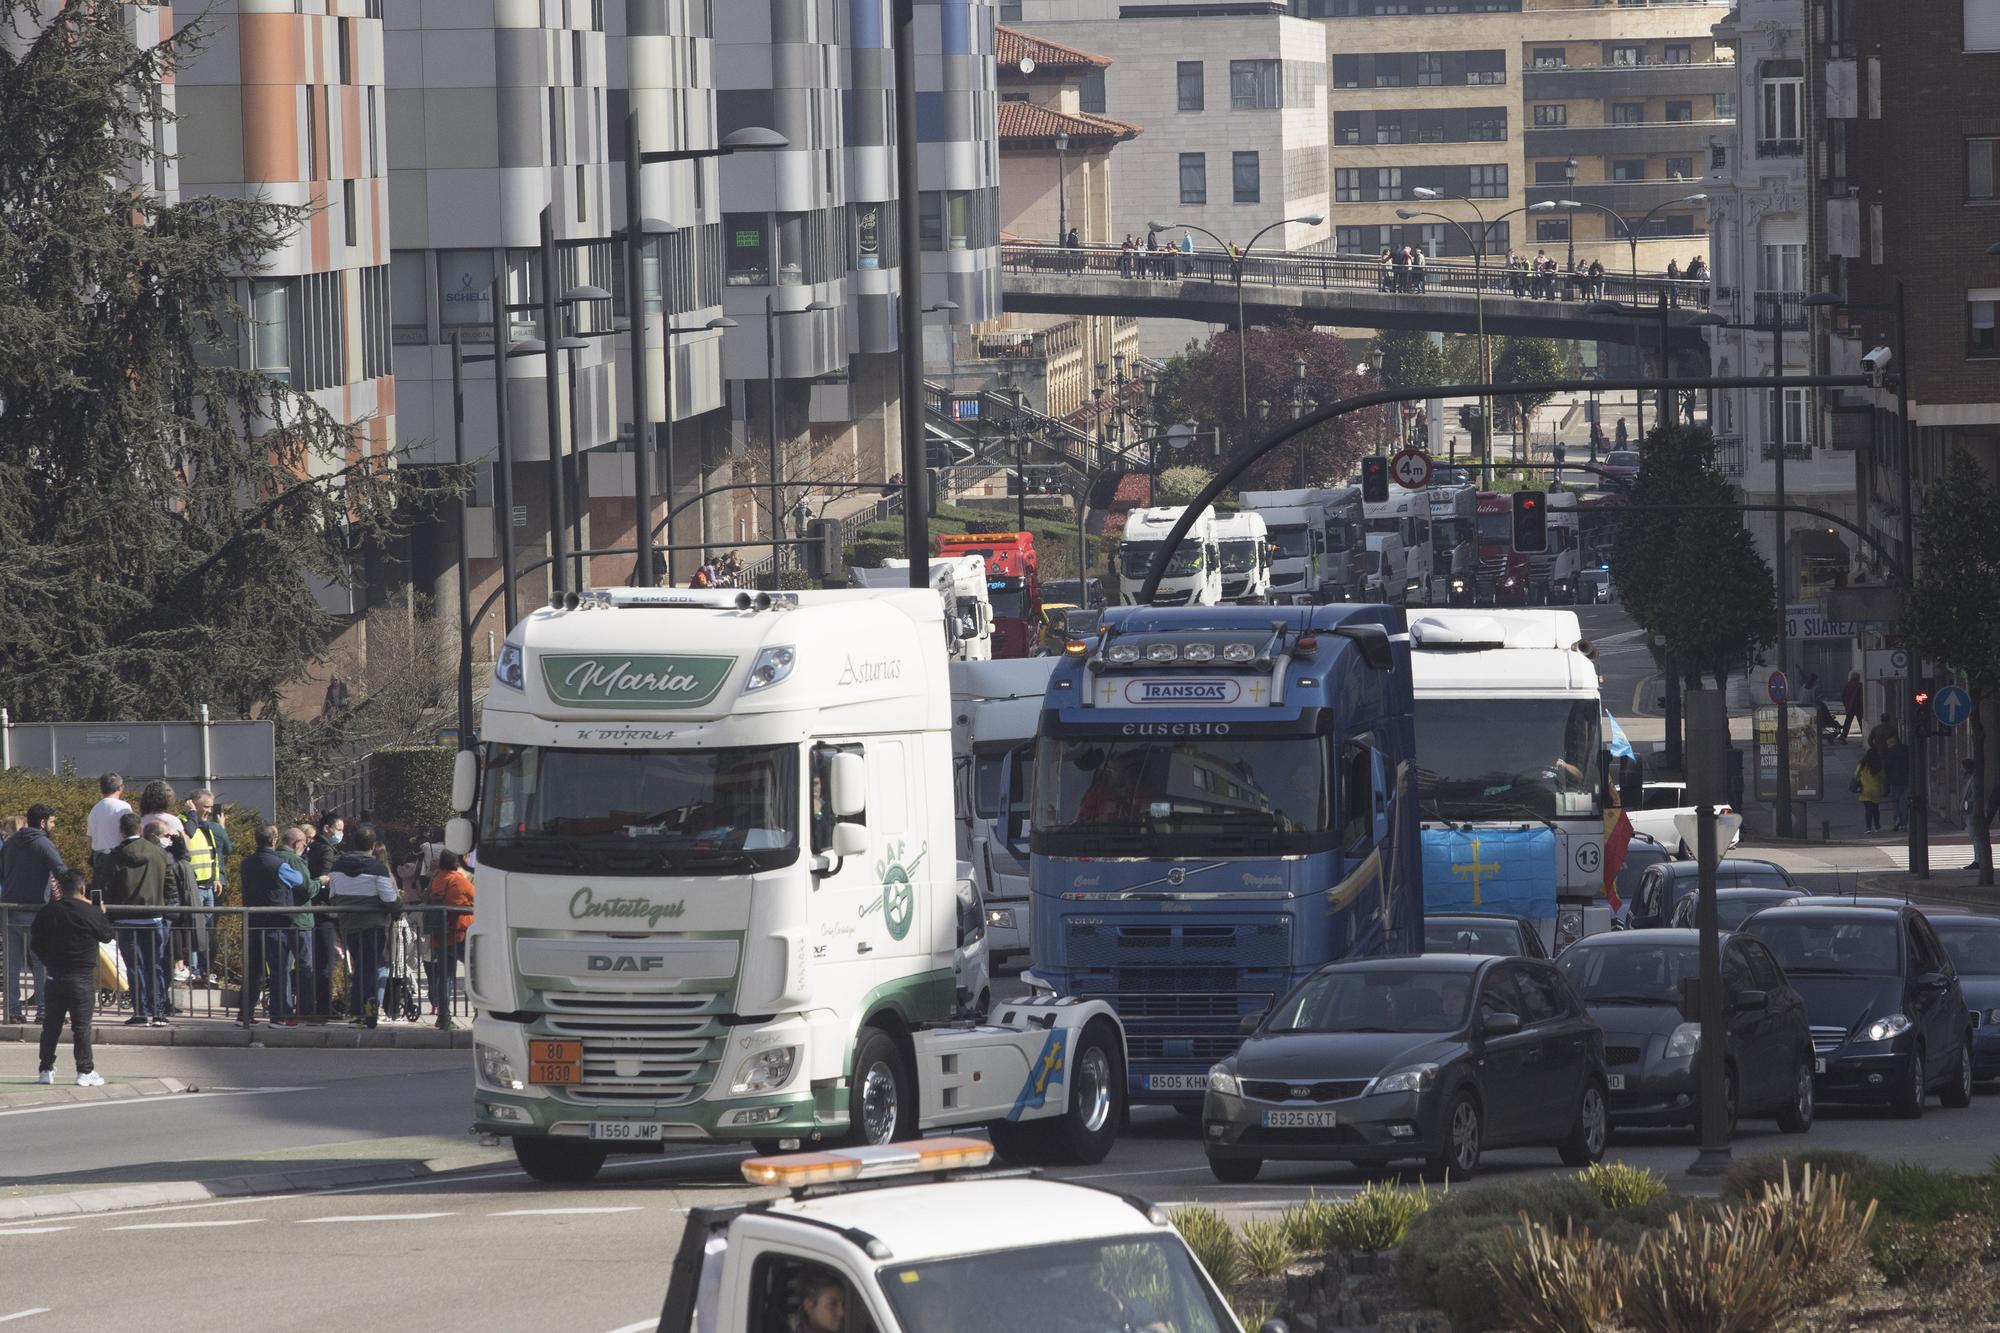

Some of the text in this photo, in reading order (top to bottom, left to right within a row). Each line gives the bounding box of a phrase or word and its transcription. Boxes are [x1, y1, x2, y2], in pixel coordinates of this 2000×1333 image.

[447, 293, 489, 302] SCHELL
[837, 652, 901, 686] Asturias
[1122, 723, 1230, 736] EUSEBIO
[1578, 850, 1599, 865] 13
[587, 955, 664, 972] DAF
[547, 1043, 563, 1059] 80
[540, 1065, 570, 1081] 1830
[1151, 1076, 1182, 1089] 8505
[1270, 1112, 1333, 1126] 6925 GXT
[600, 1125, 658, 1138] 1550 JMP
